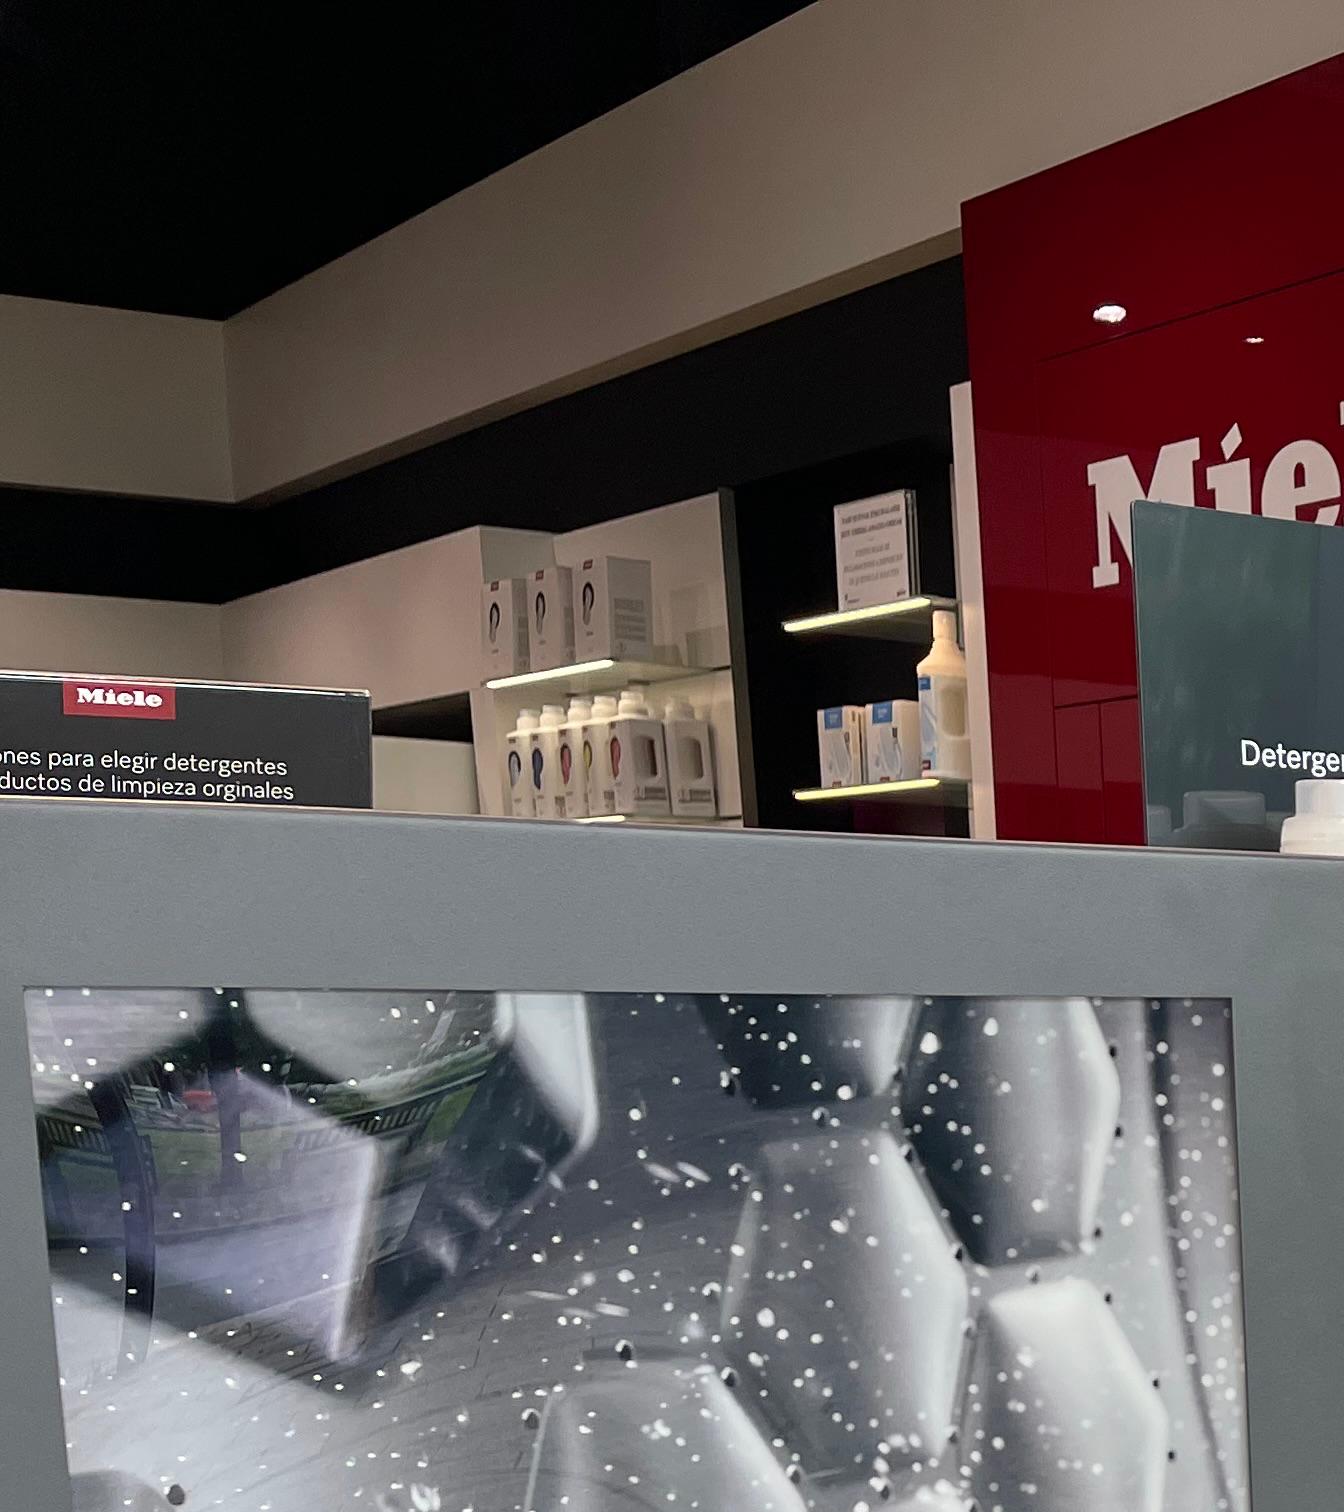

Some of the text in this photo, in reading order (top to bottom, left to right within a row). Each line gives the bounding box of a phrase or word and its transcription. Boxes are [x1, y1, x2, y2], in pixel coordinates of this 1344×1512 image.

[76, 687, 163, 708] Miele
[0, 749, 288, 778] nes para elegir detergentes
[78, 773, 105, 793] de
[111, 774, 197, 798] limpieza
[202, 781, 294, 802] orginales
